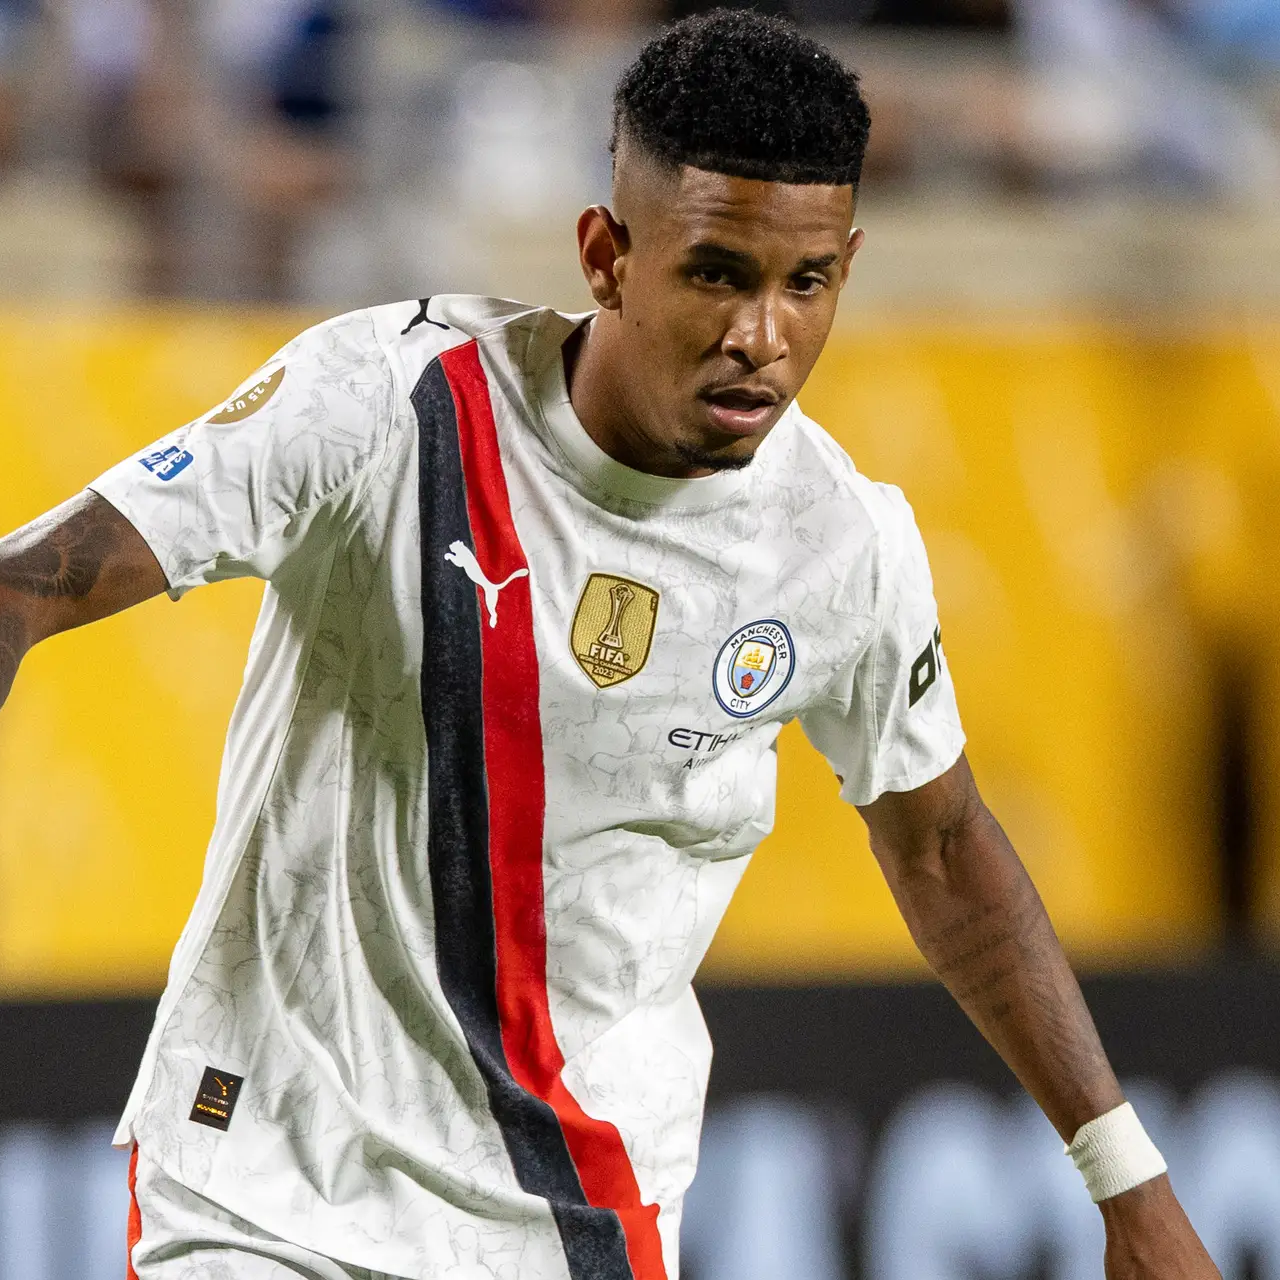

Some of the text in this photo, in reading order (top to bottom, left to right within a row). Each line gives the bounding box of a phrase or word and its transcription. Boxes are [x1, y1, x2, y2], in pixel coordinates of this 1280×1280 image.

[730, 625, 787, 660] MANCHESTER
[590, 644, 625, 666] FIFA
[593, 665, 614, 678] 2023
[730, 698, 752, 710] CITY
[667, 727, 754, 753] ETIH
